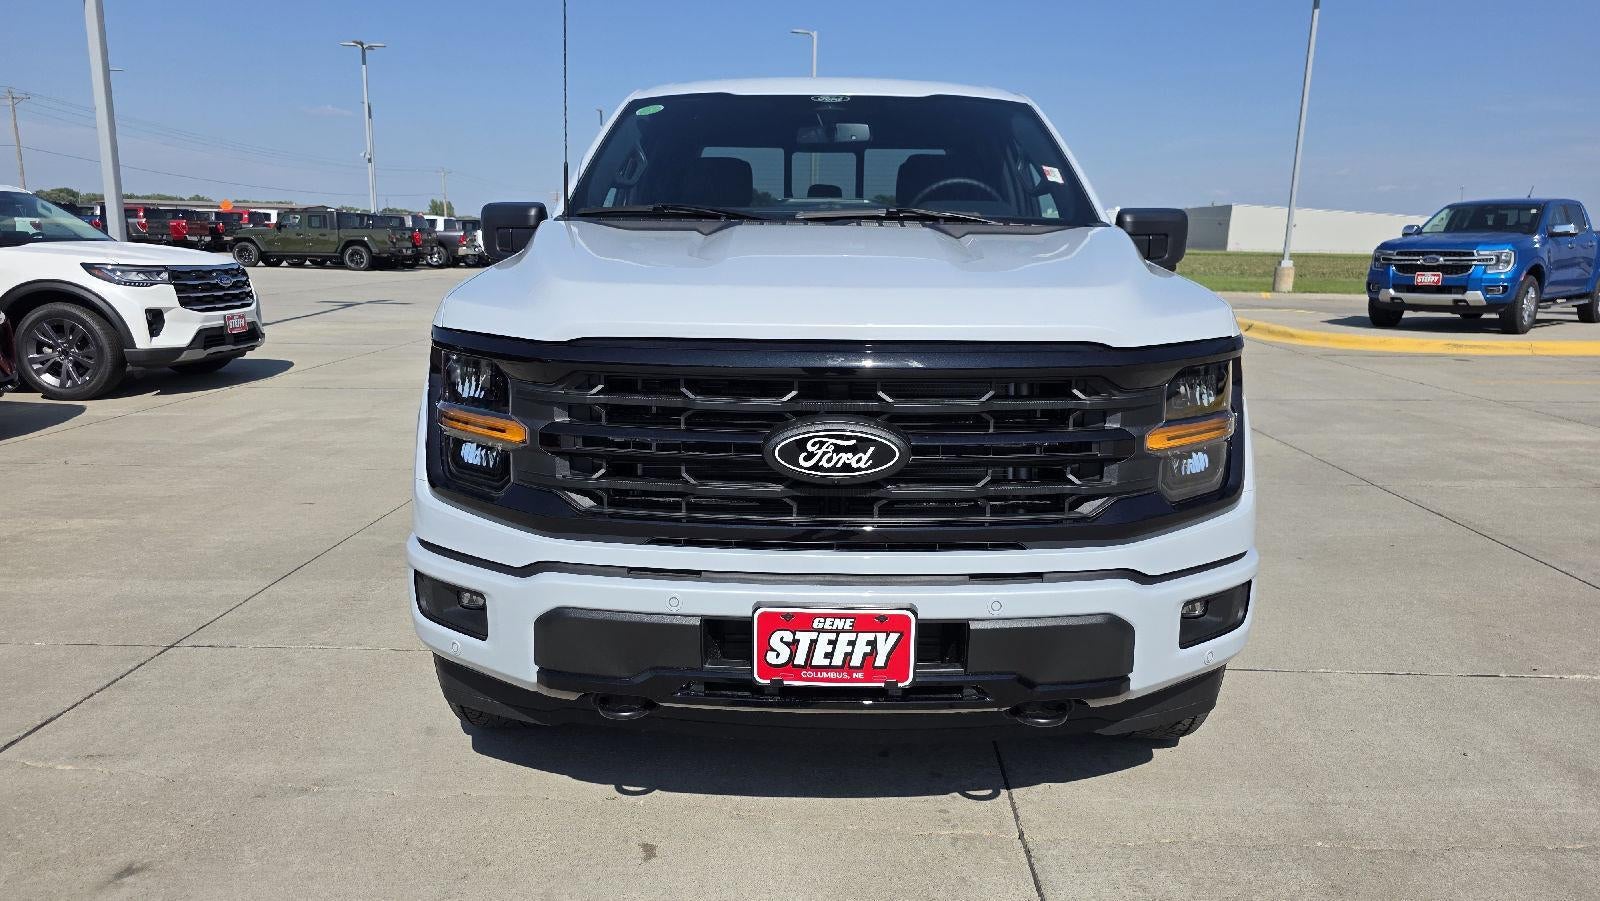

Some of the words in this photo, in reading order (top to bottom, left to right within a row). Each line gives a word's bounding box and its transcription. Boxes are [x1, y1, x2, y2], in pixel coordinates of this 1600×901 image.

[798, 437, 875, 468] Ford
[812, 617, 855, 630] GENE
[764, 628, 904, 669] STEFFY
[801, 671, 850, 680] COLUMBUS,
[852, 671, 864, 679] NE
